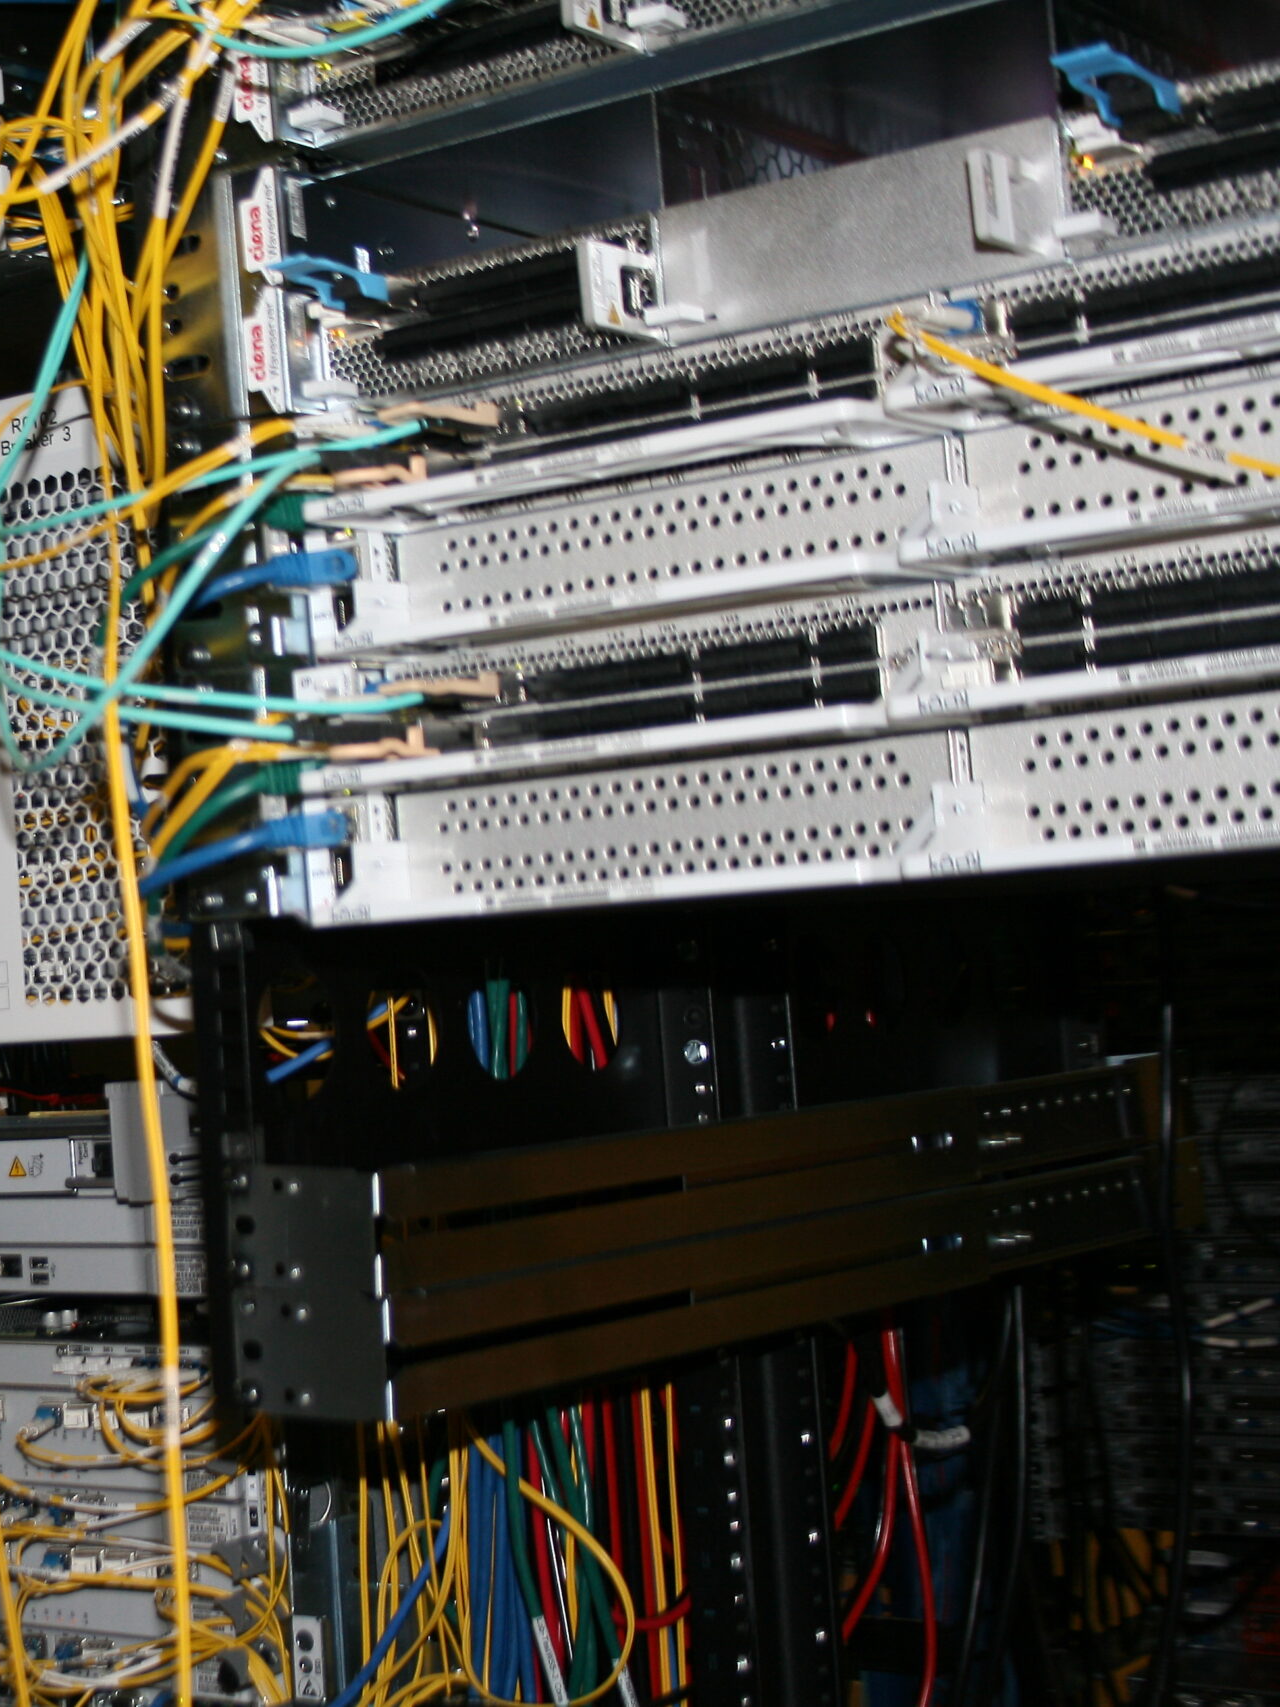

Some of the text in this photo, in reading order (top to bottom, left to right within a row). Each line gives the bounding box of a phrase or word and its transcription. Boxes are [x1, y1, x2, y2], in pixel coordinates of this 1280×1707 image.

[250, 206, 265, 262] ciena
[251, 326, 265, 381] ciena
[63, 426, 71, 442] 3
